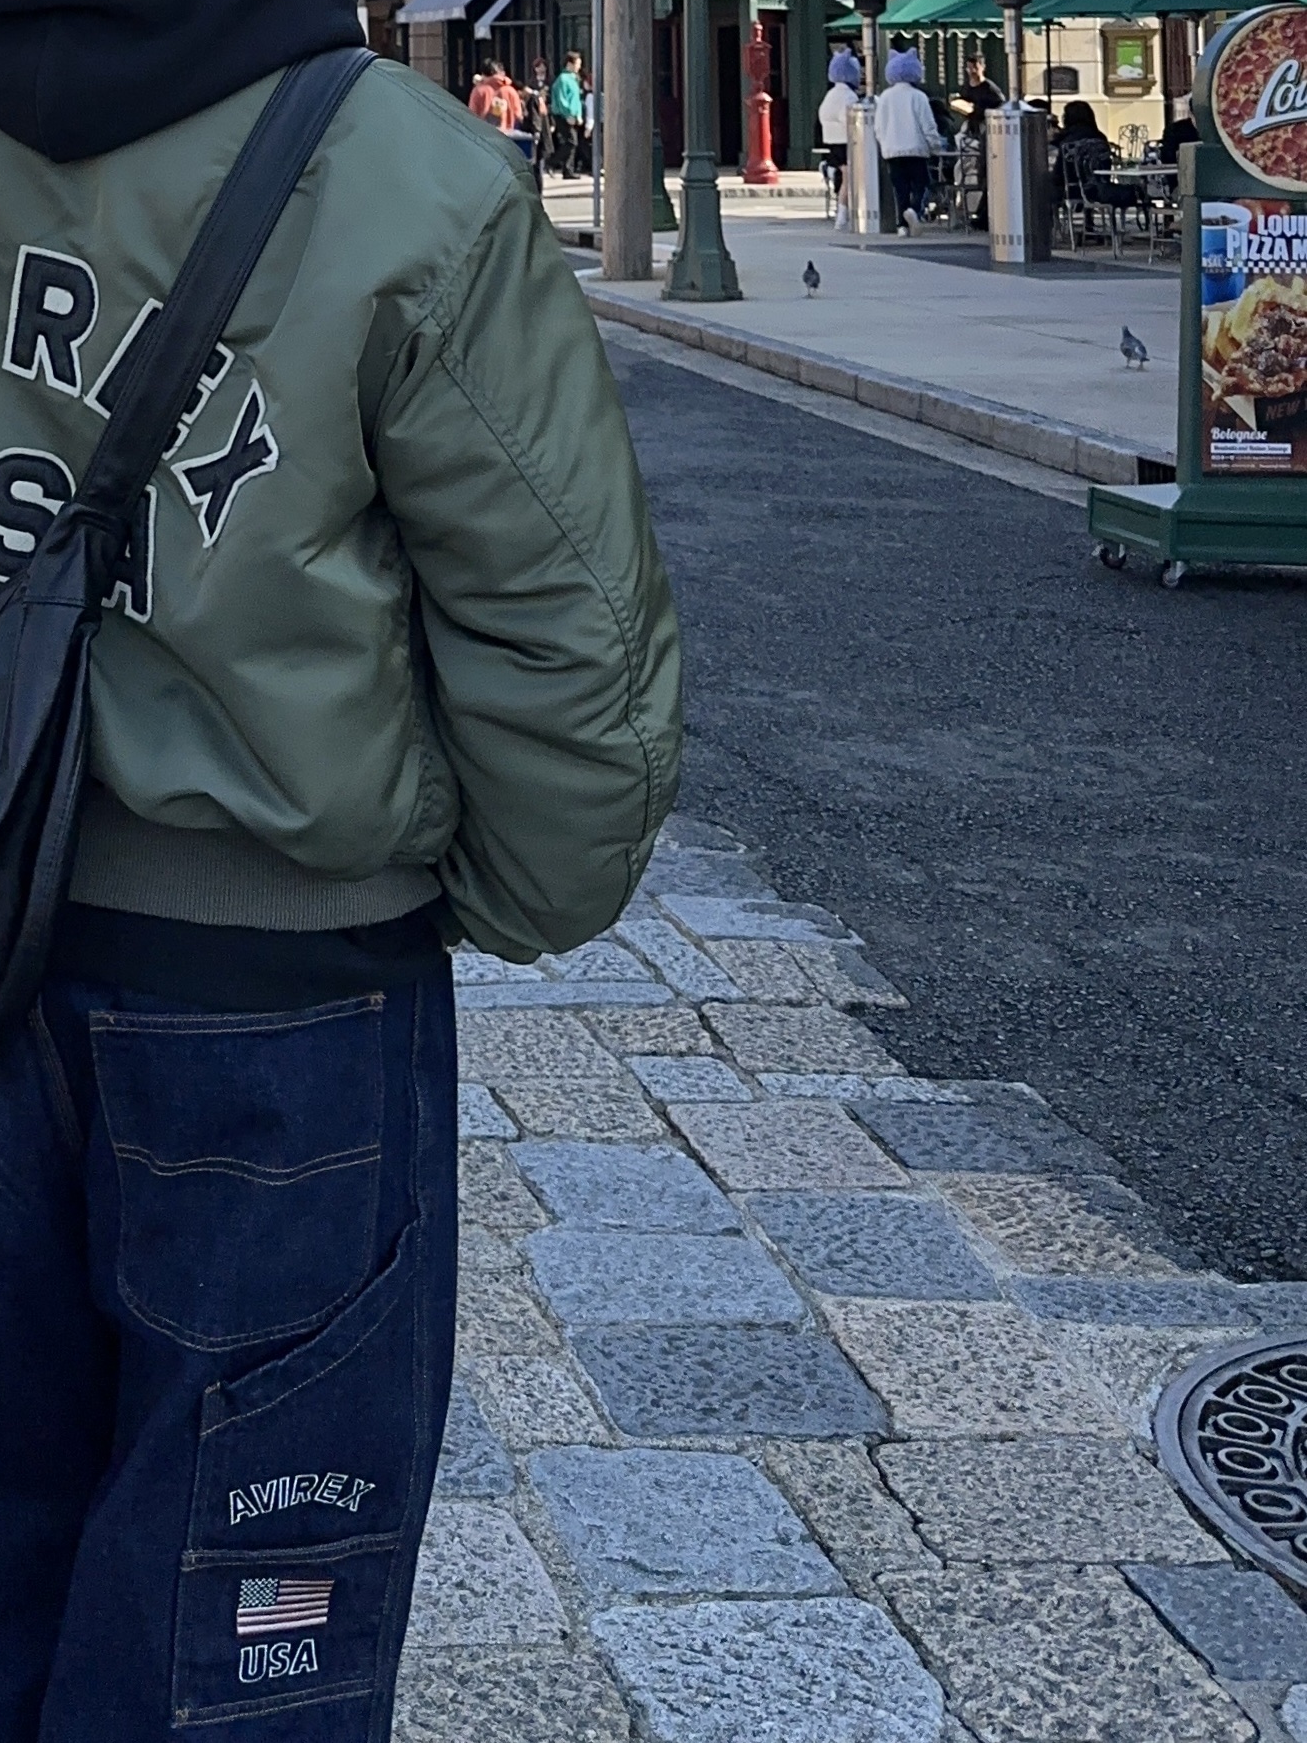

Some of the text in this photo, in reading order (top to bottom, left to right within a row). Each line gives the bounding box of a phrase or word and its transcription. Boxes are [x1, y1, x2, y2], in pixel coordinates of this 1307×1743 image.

[1226, 227, 1289, 261] PIZZA
[1210, 427, 1268, 444] Bolognese
[229, 1472, 376, 1526] AVIREX
[238, 1638, 319, 1683] USA
